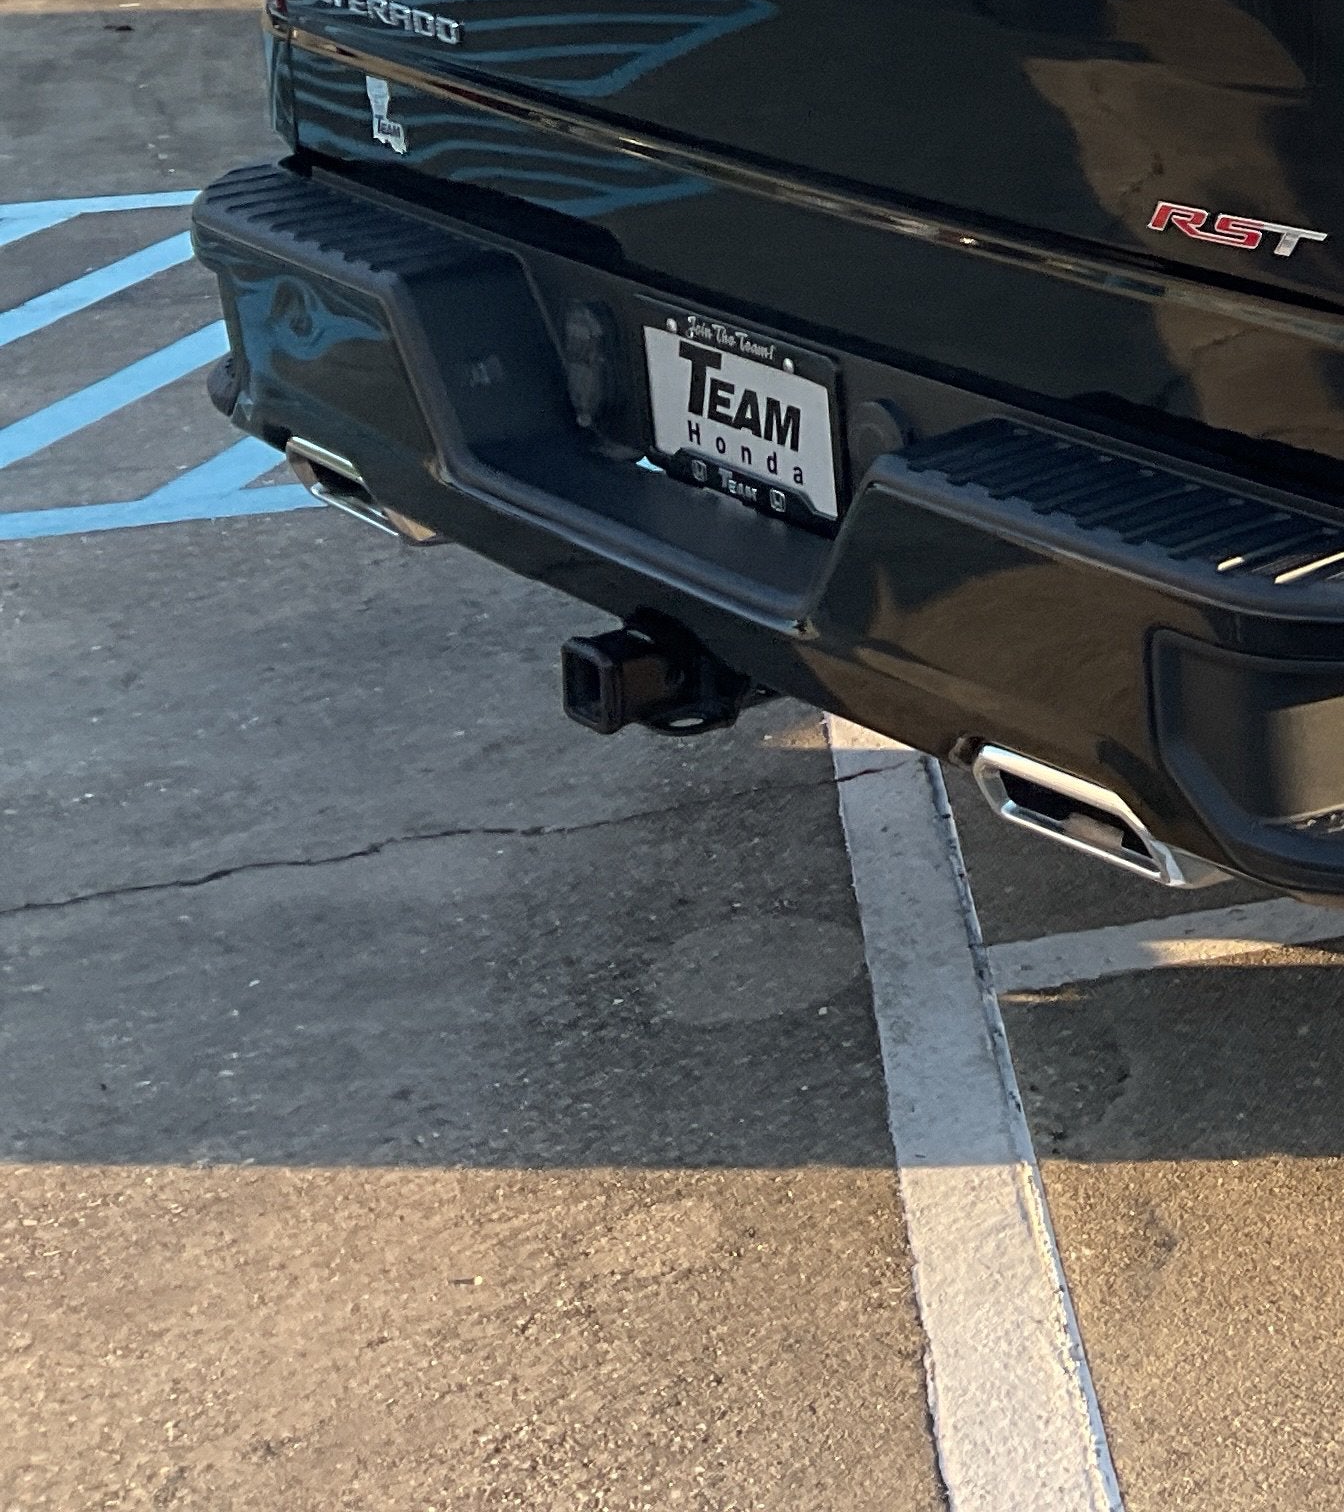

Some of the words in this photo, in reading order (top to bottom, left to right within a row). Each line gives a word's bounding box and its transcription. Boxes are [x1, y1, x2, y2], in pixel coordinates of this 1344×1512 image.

[1147, 200, 1328, 257] RST
[711, 324, 736, 346] The
[678, 340, 801, 452] TEAM
[687, 420, 803, 486] Honda
